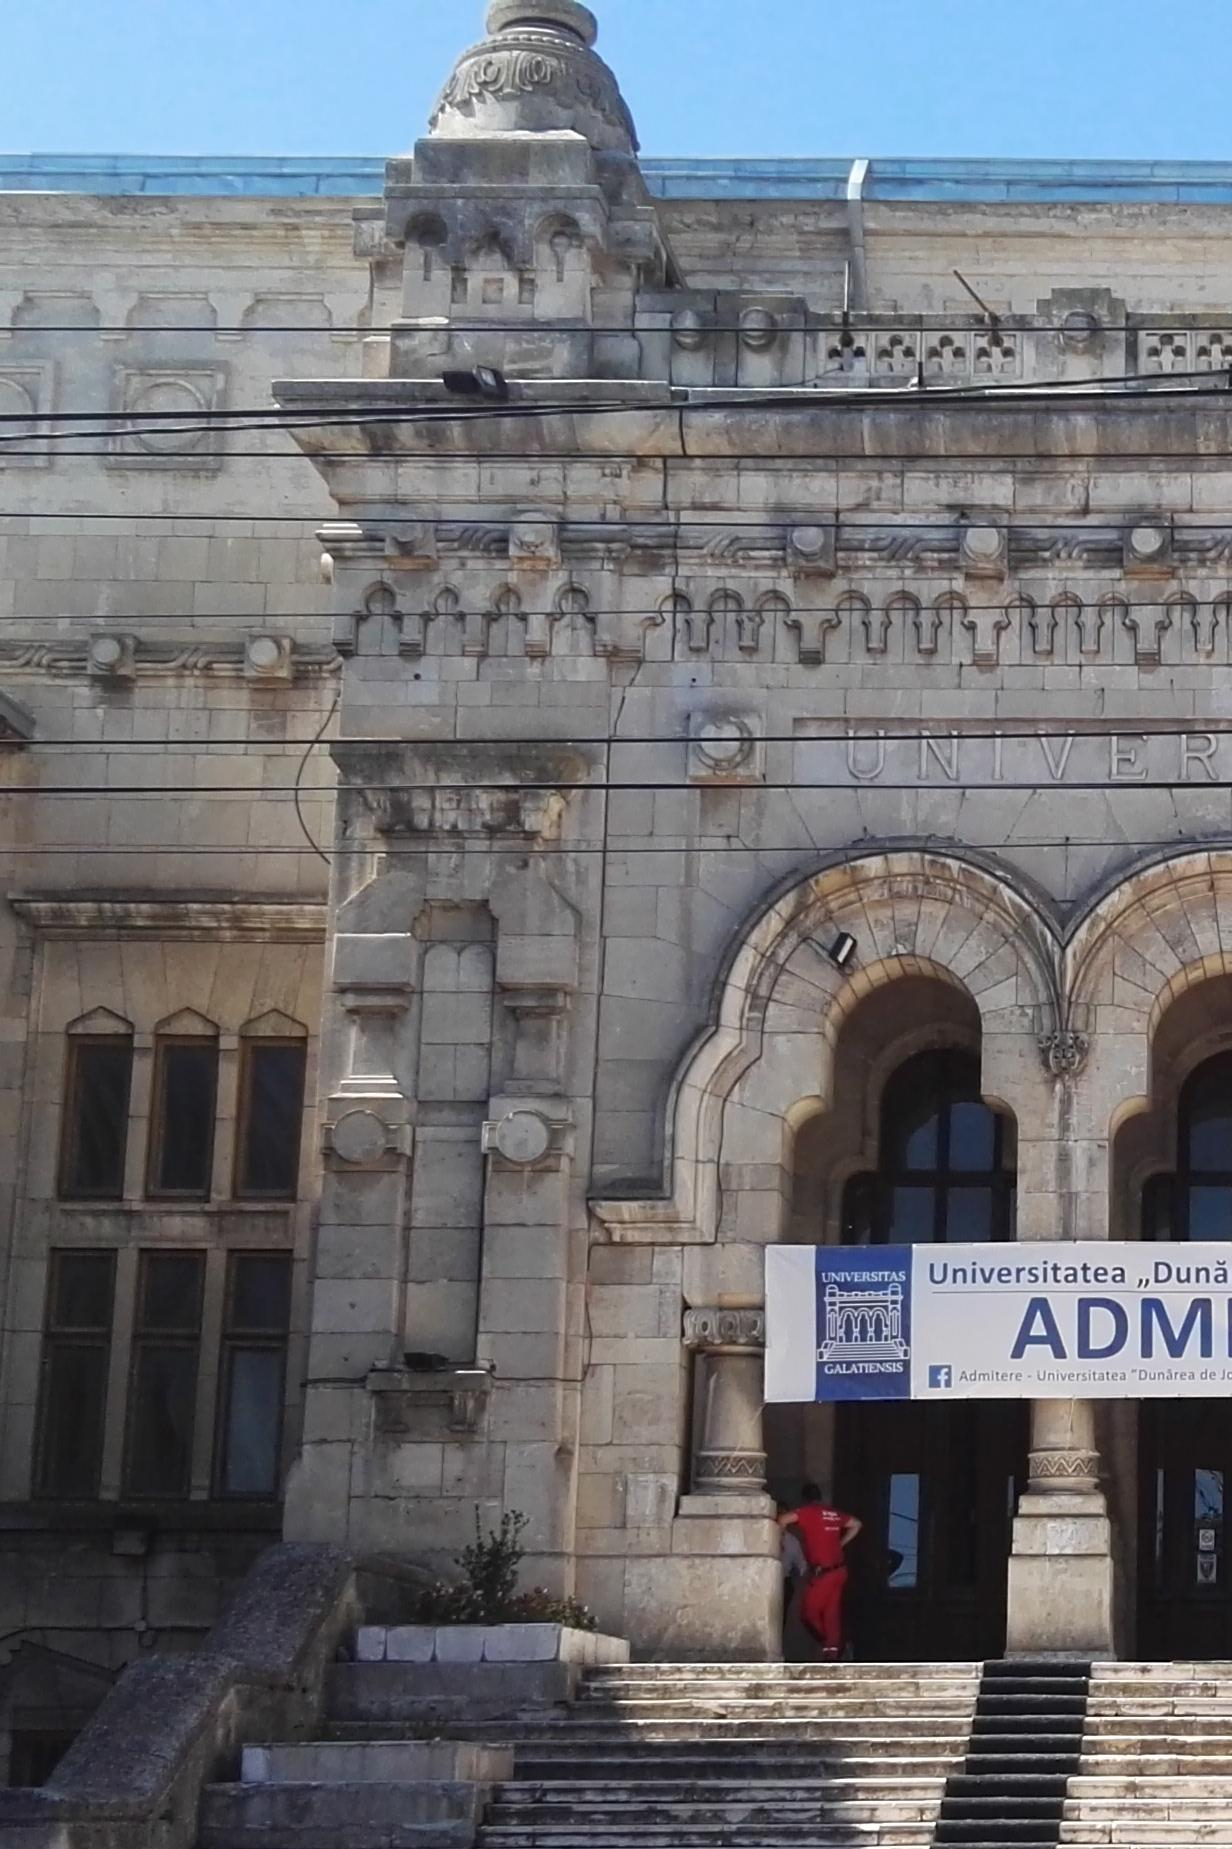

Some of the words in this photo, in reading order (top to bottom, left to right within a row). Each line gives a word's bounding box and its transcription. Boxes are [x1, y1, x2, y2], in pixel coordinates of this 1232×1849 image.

[821, 1271, 906, 1283] UNIVERSITAS
[929, 1261, 1126, 1285] Universitatea
[824, 1362, 904, 1374] GALATIENSIS
[959, 1369, 1023, 1382] Admitere
[1036, 1369, 1127, 1382] Universitatea
[1200, 1368, 1217, 1381] de
